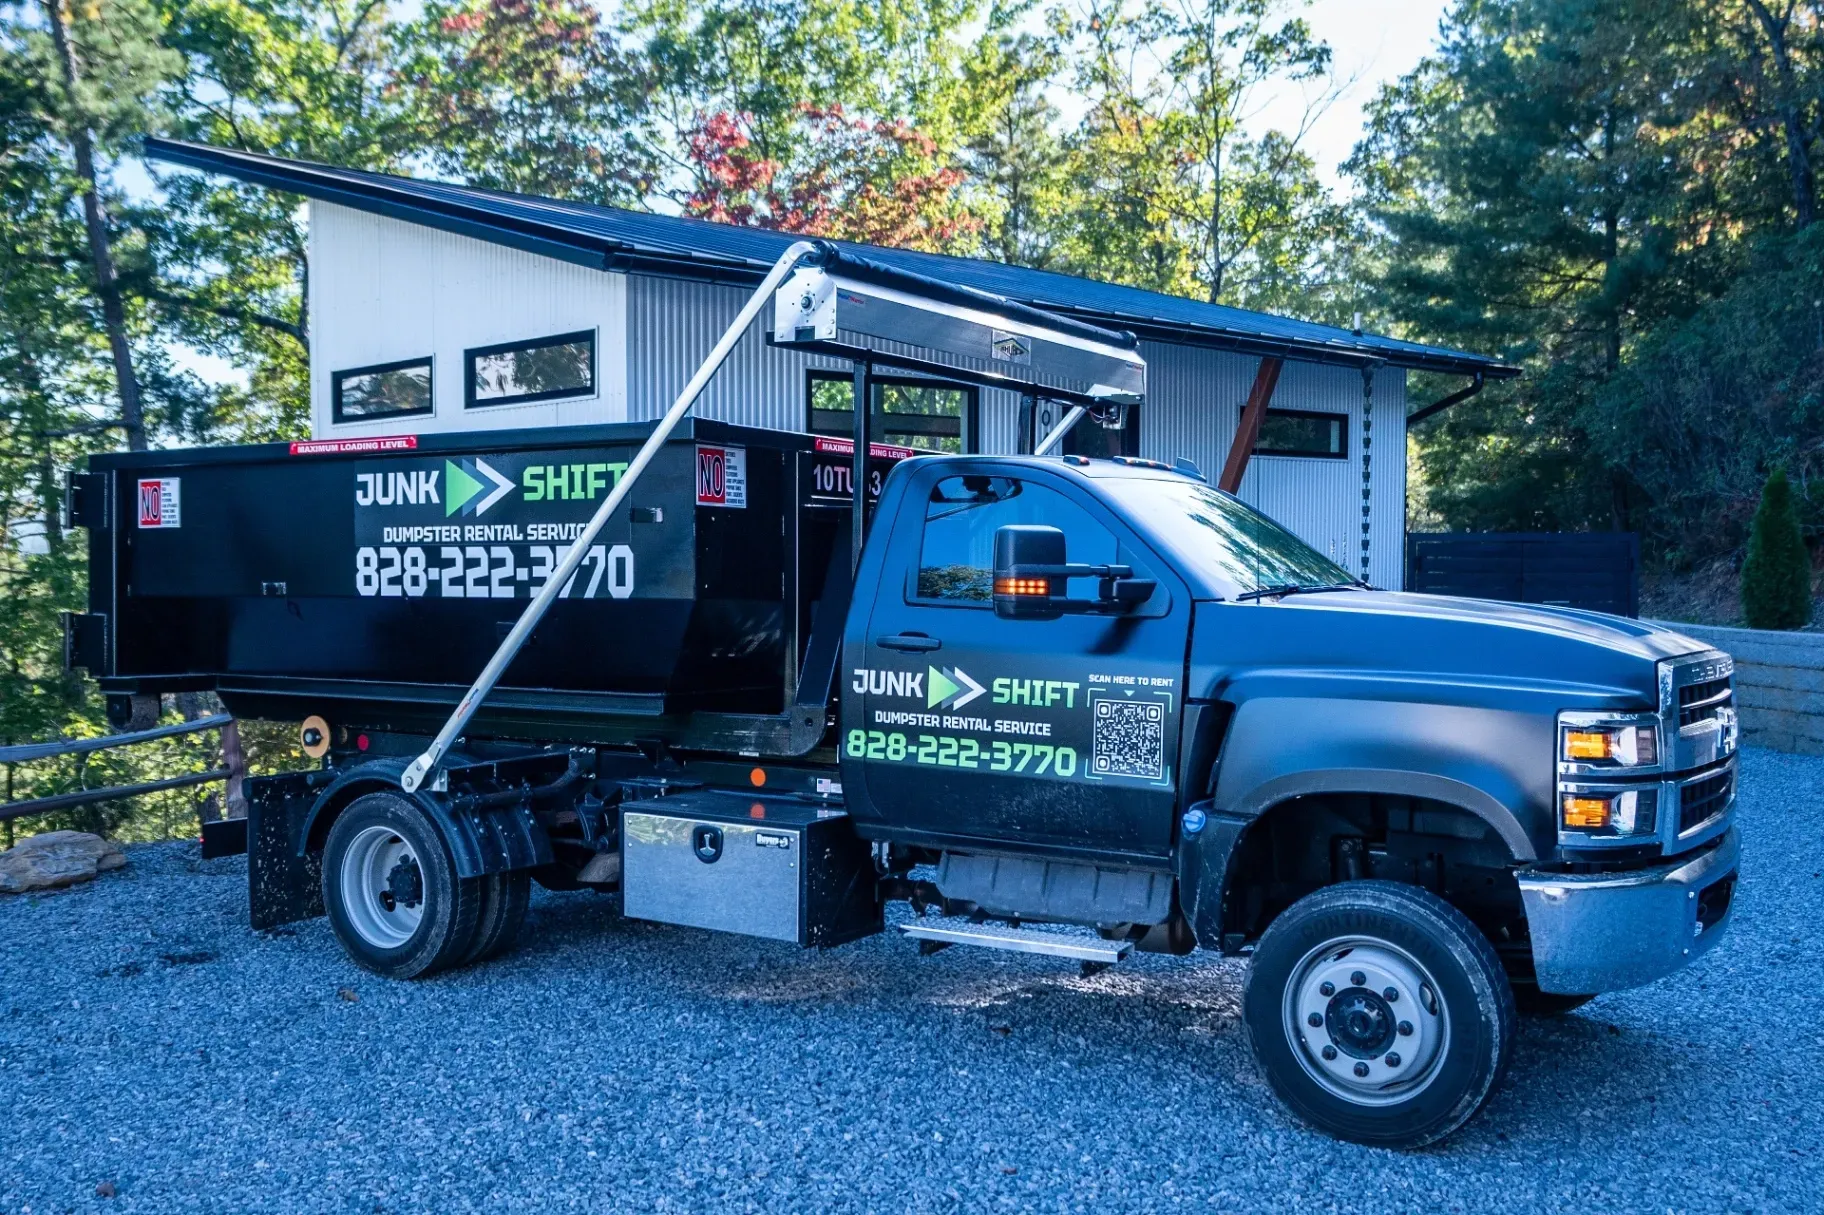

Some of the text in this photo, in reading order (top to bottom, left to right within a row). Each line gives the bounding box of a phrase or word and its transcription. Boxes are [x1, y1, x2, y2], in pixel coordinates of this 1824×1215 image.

[297, 440, 408, 454] MAXIMUM LOADING LEVEL
[888, 450, 908, 459] LEVEL
[356, 462, 629, 506] JUNK SHIFT
[699, 453, 724, 498] NO
[141, 486, 160, 521] NO
[384, 523, 589, 543] DUMPSTER RENTAL SERVIC
[852, 669, 1080, 708] JUNK SHIFT
[1088, 674, 1174, 687] SCAN HERE TO RENT
[875, 710, 1051, 737] DUMPSTER RENTAL SERVICE
[847, 729, 1077, 777] 828-222-3770
